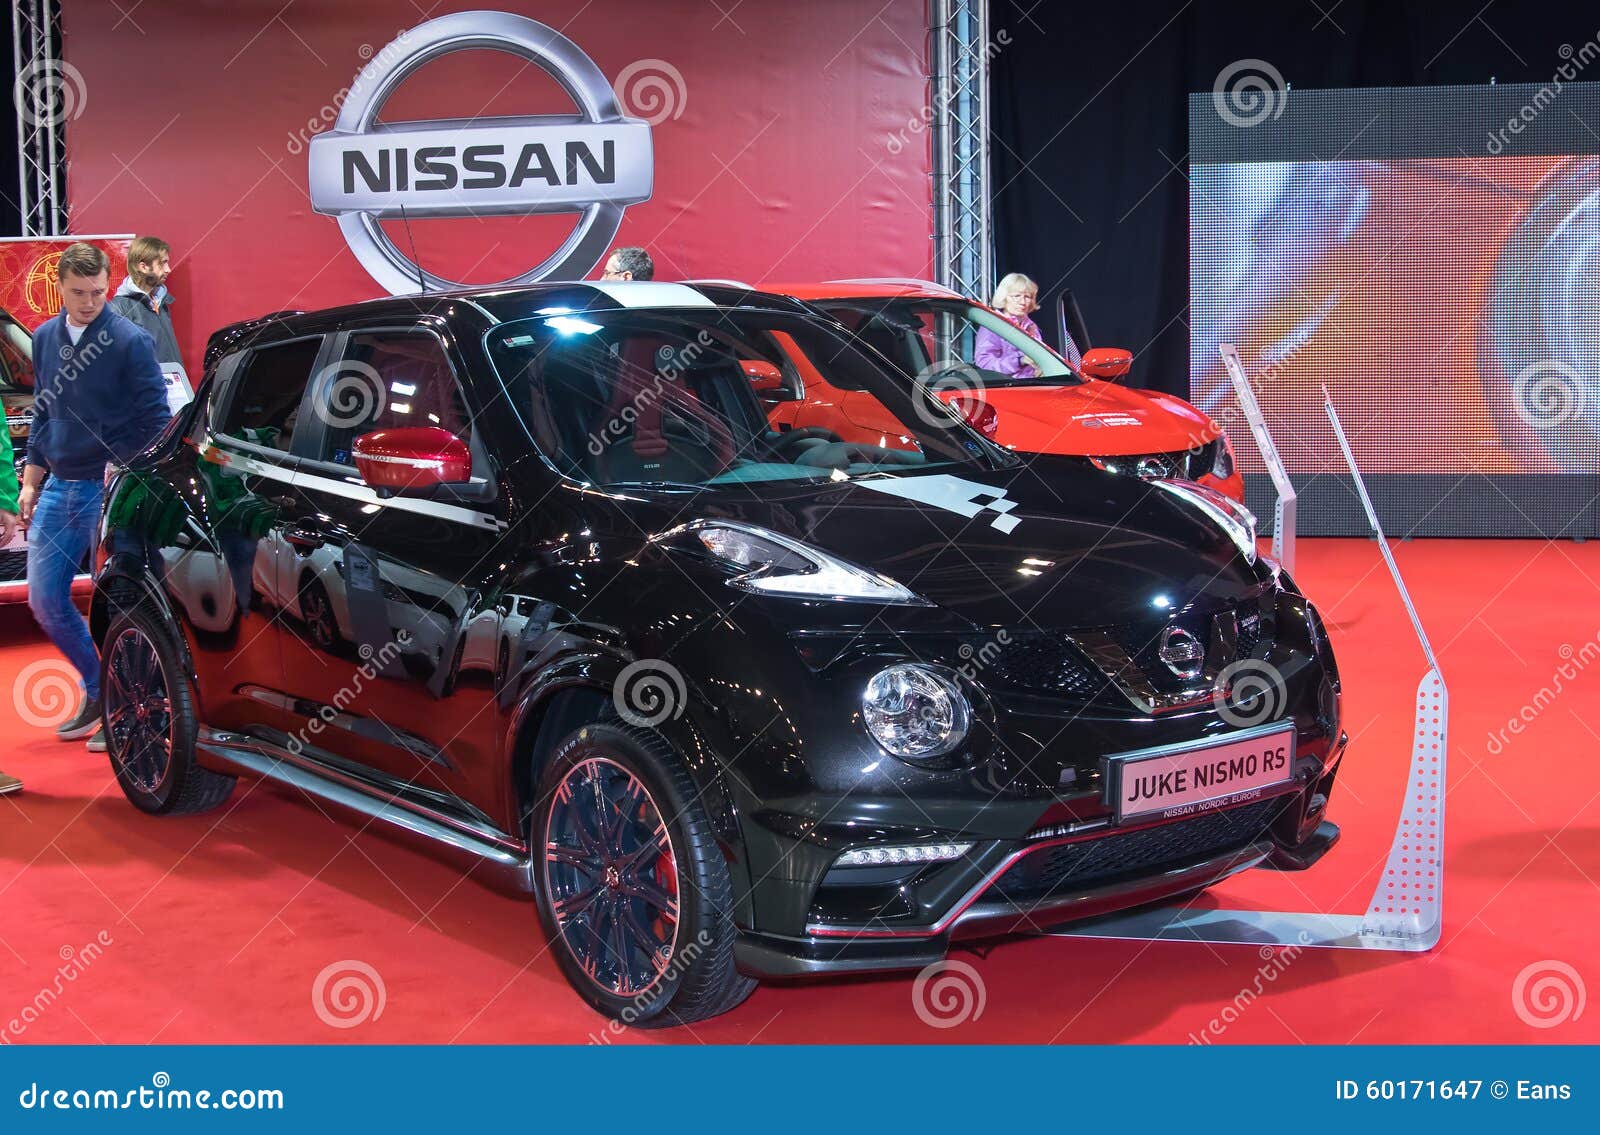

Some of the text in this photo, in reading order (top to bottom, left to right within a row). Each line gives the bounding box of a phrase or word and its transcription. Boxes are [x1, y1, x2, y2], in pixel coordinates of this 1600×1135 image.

[343, 140, 615, 194] NISSAN
[1127, 747, 1285, 802] JUKE NISMO RS
[1163, 789, 1262, 819] NISSAN NORDIC EUROPE
